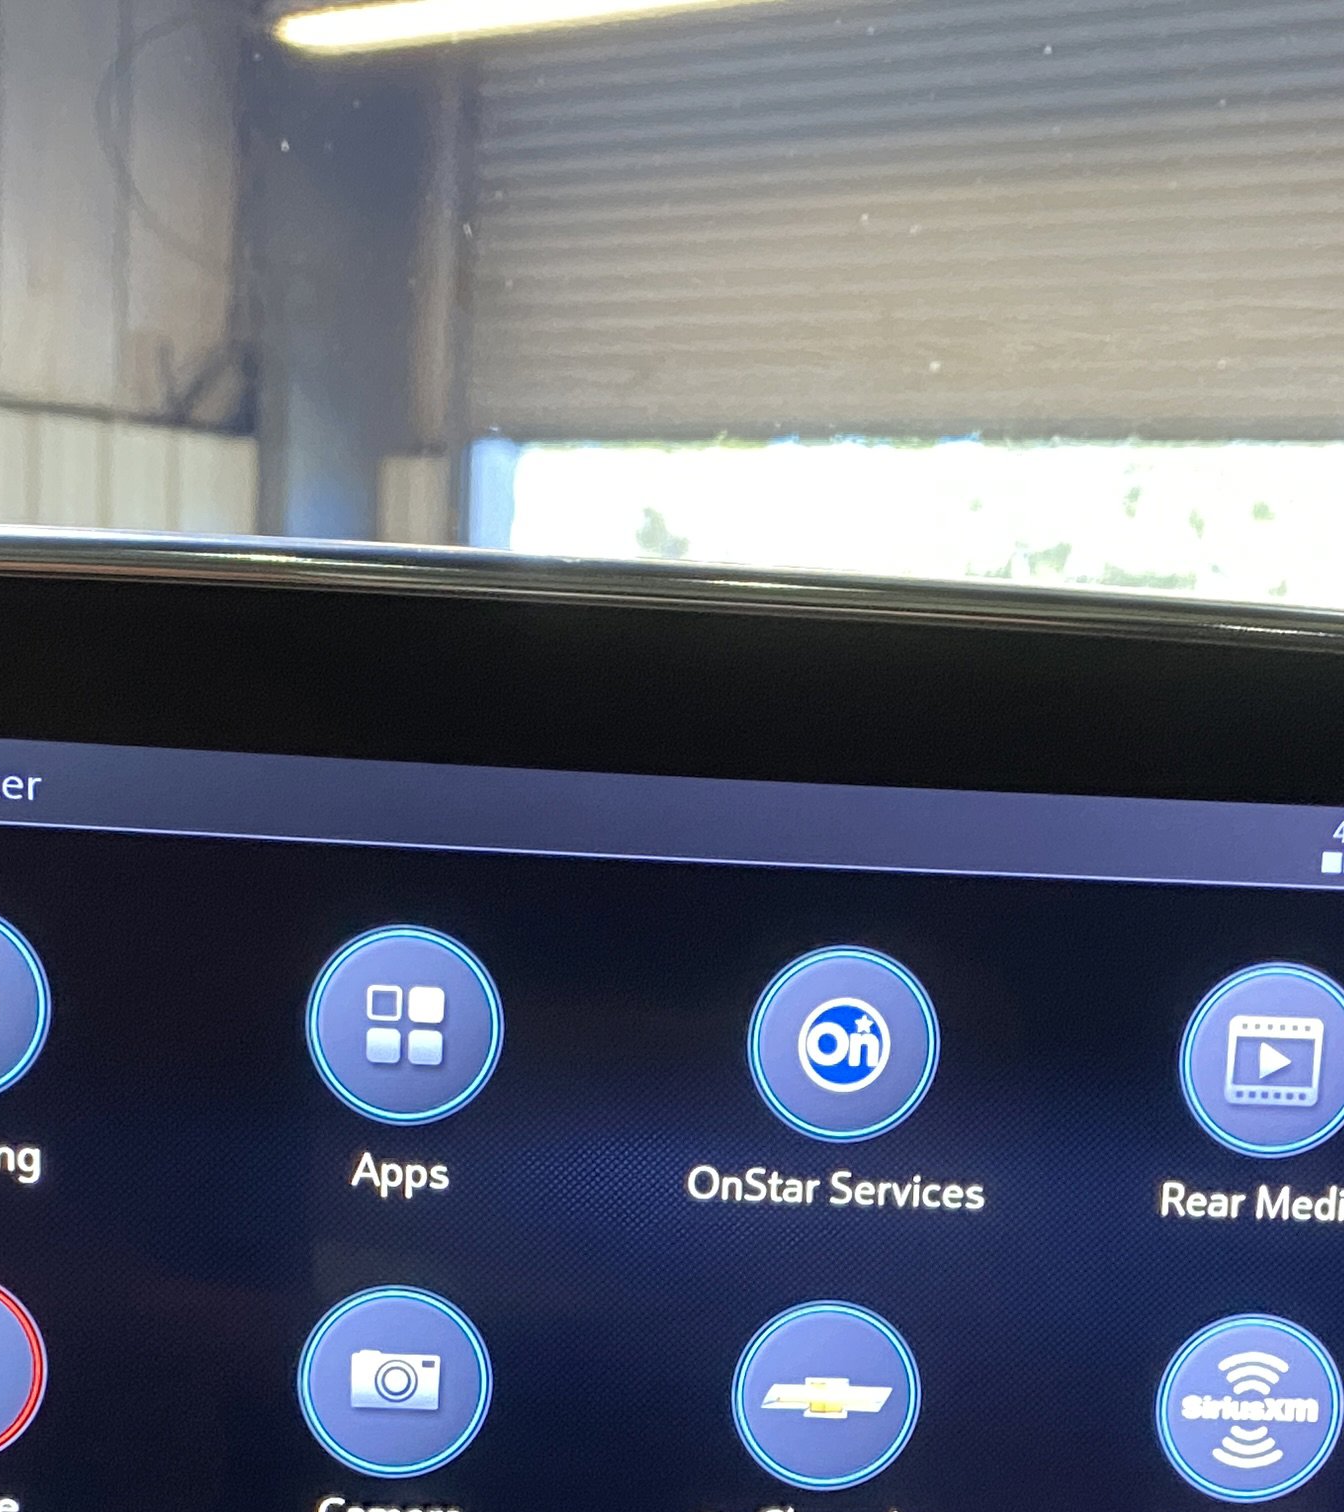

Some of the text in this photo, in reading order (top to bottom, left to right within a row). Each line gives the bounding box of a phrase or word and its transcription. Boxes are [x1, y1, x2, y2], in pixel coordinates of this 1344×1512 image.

[349, 1150, 451, 1200] Apps
[686, 1163, 986, 1211] OnStar Services
[1160, 1180, 1247, 1220] Rear
